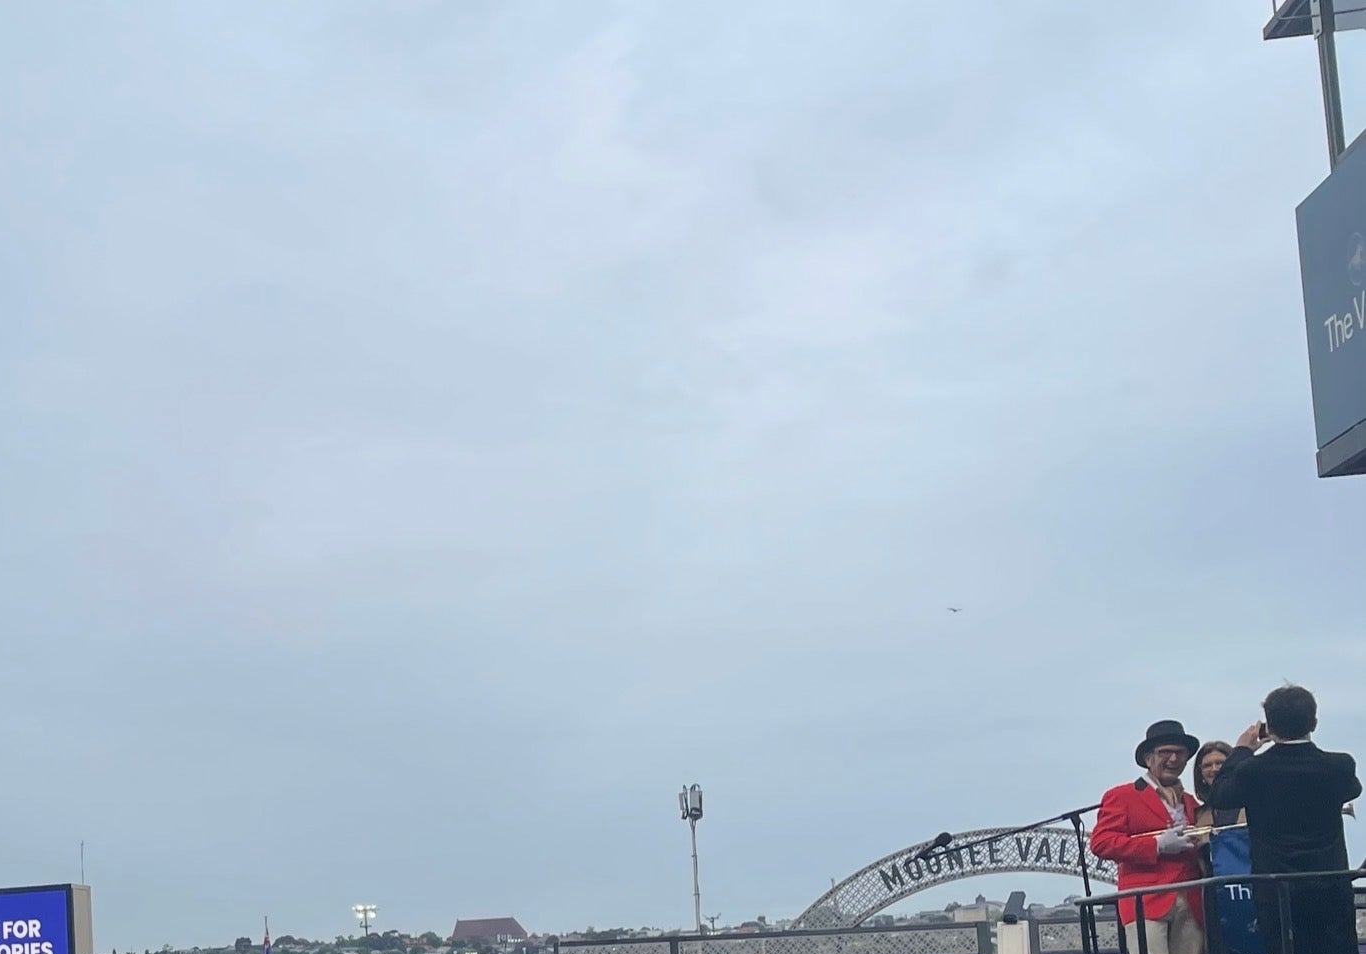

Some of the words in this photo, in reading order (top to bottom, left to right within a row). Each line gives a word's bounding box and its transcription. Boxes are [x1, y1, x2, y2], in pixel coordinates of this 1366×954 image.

[1324, 313, 1353, 352] The
[879, 840, 1003, 892] MOONEE
[1015, 837, 1110, 873] VALL
[1224, 884, 1252, 900] Th
[3, 919, 41, 939] FOR
